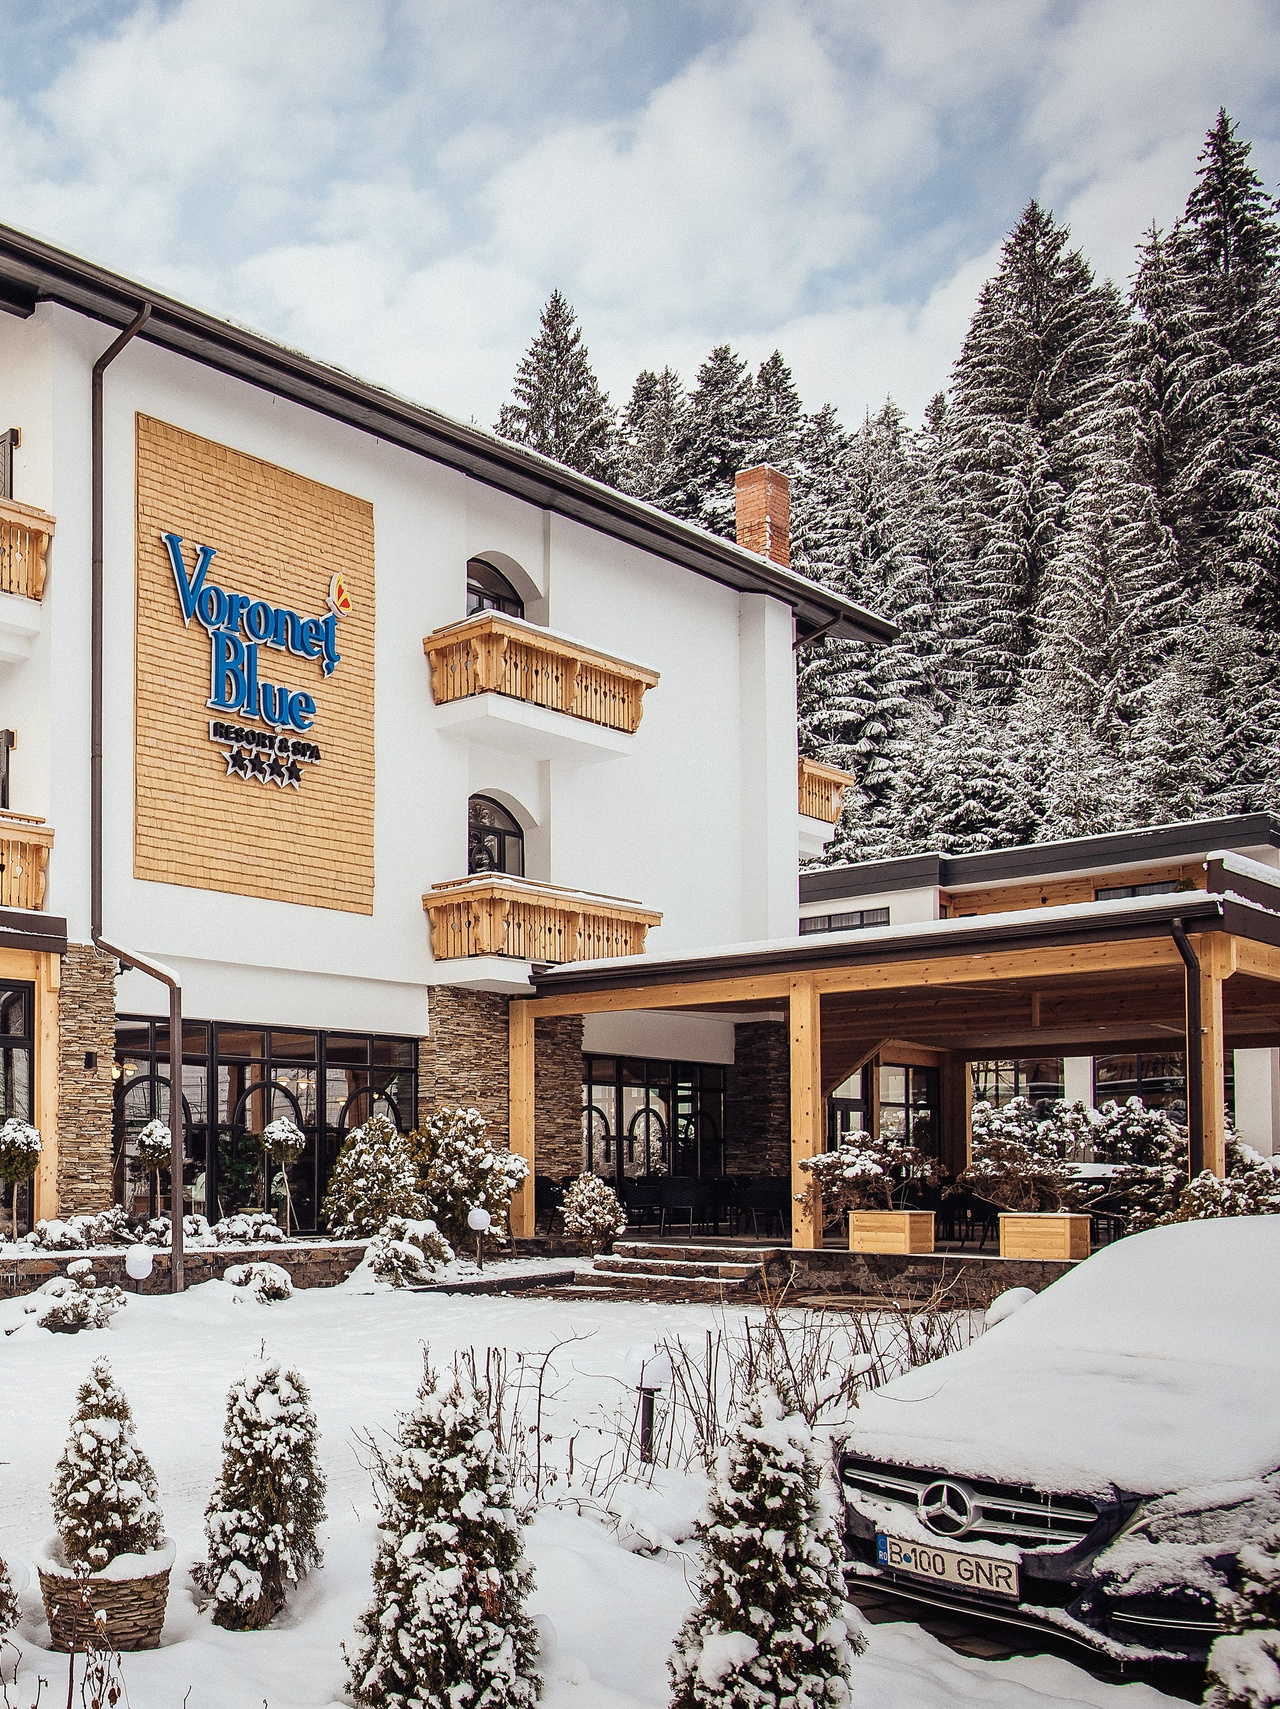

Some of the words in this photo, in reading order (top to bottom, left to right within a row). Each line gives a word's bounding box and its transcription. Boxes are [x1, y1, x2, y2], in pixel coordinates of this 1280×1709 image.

[208, 630, 317, 731] Blue
[212, 721, 278, 750] RESORT
[277, 737, 290, 753] &
[290, 740, 322, 761] SPA
[878, 1550, 888, 1561] RO
[956, 1558, 1014, 1591] GNR
